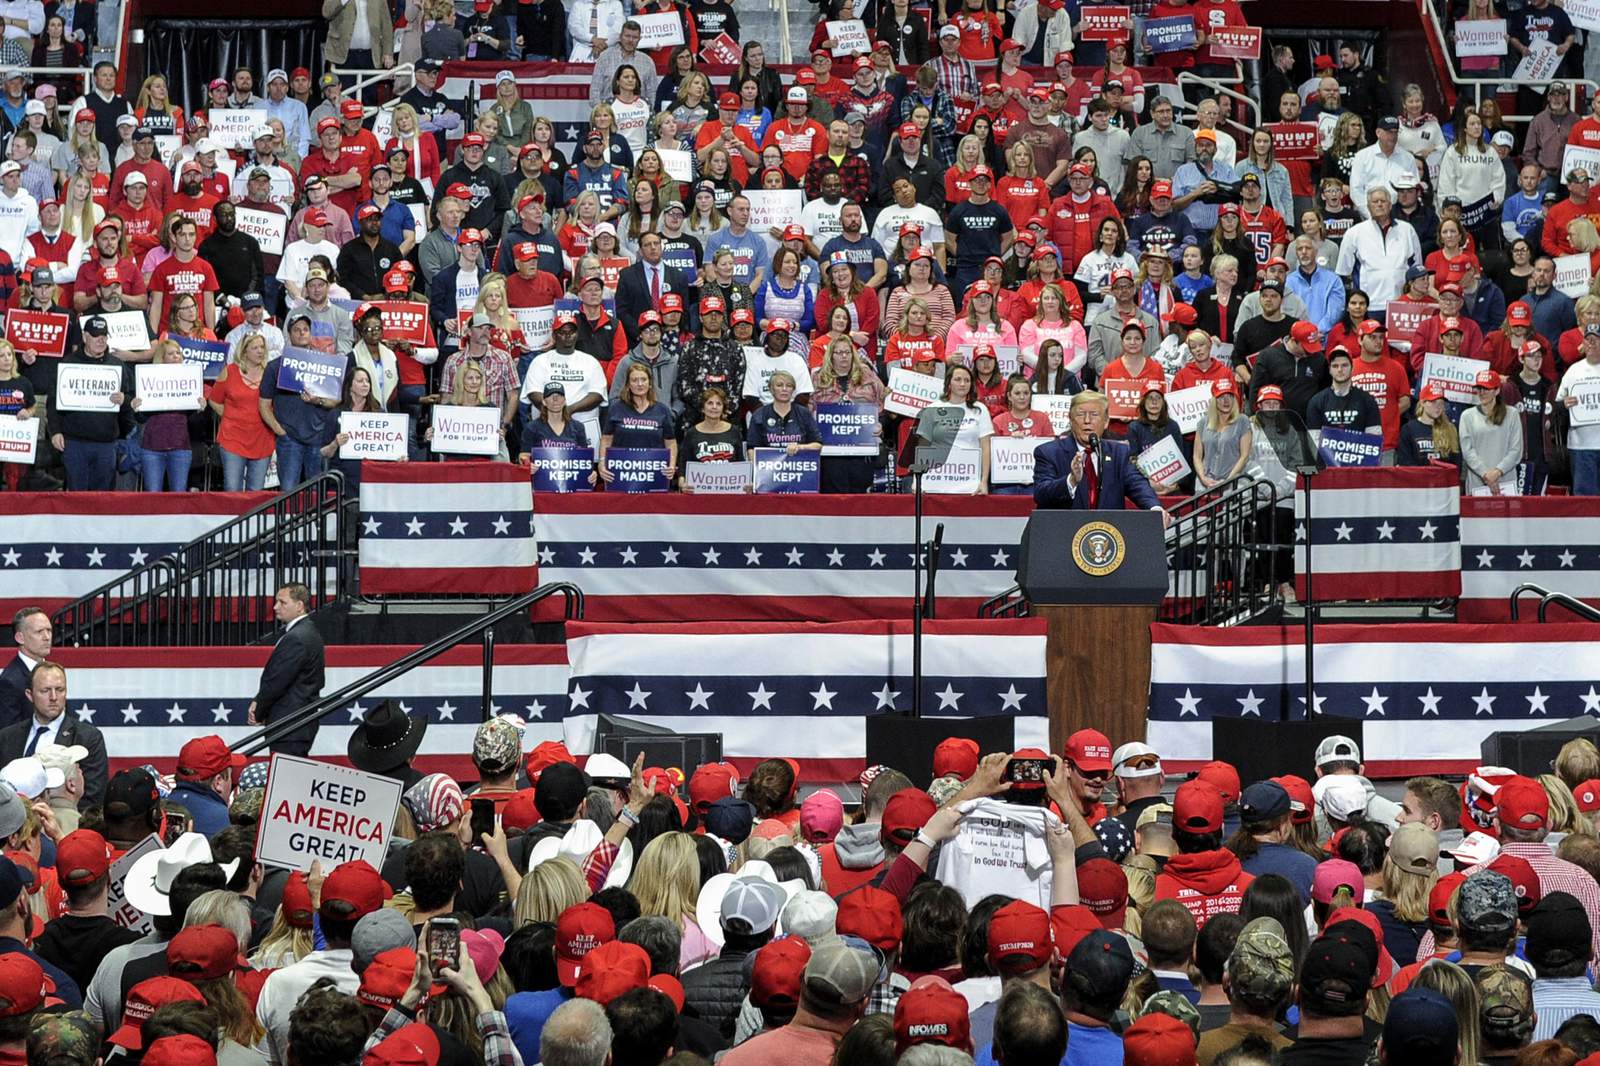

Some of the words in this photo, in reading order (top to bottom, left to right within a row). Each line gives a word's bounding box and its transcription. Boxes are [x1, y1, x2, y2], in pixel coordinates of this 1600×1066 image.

[697, 14, 727, 22] TRUMP
[1146, 24, 1193, 36] PROMISES
[1458, 30, 1502, 41] Women
[1158, 34, 1182, 44] KEPT
[1215, 32, 1258, 41] TRUMP
[1528, 46, 1552, 79] MERICA
[620, 120, 644, 129] 2020
[1458, 156, 1494, 165] TRUMP
[243, 215, 269, 224] KEEP
[167, 274, 205, 284] TRUMP
[12, 321, 63, 334] TRUMP
[521, 319, 553, 333] TERANS
[15, 330, 57, 340] PENCE
[897, 340, 933, 349] WOMEN
[283, 358, 342, 377] PROMISES
[1429, 363, 1474, 382] Latino
[295, 372, 326, 384] KEPT
[69, 379, 116, 391] VETERANS
[142, 377, 197, 391] Women
[894, 378, 938, 400] Latino
[893, 393, 910, 403] FOR
[1111, 390, 1141, 398] TRU
[360, 420, 389, 428] KEEP
[623, 418, 659, 427] Women
[818, 413, 875, 424] PROMISES
[438, 418, 494, 434] Women
[832, 426, 861, 435] KEPT
[348, 431, 403, 442] AMERICA
[767, 433, 801, 442] Women
[354, 443, 394, 452] GREAT!
[697, 441, 734, 453] Trump
[1322, 438, 1380, 455] PROMISES
[996, 450, 1033, 464] Wom
[1334, 452, 1364, 464] KEPT
[534, 459, 592, 469] PROMISES
[608, 460, 667, 469] PROMISES
[758, 461, 818, 472] PROMISES
[920, 459, 975, 474] Women
[549, 471, 579, 481] KEPT
[619, 471, 655, 481] MADE
[691, 471, 746, 485] Women
[773, 472, 802, 482] KEPT
[310, 779, 366, 807] KEEP
[272, 800, 383, 845] AMERICA
[289, 833, 365, 862] GREAT!
[982, 858, 996, 866] God
